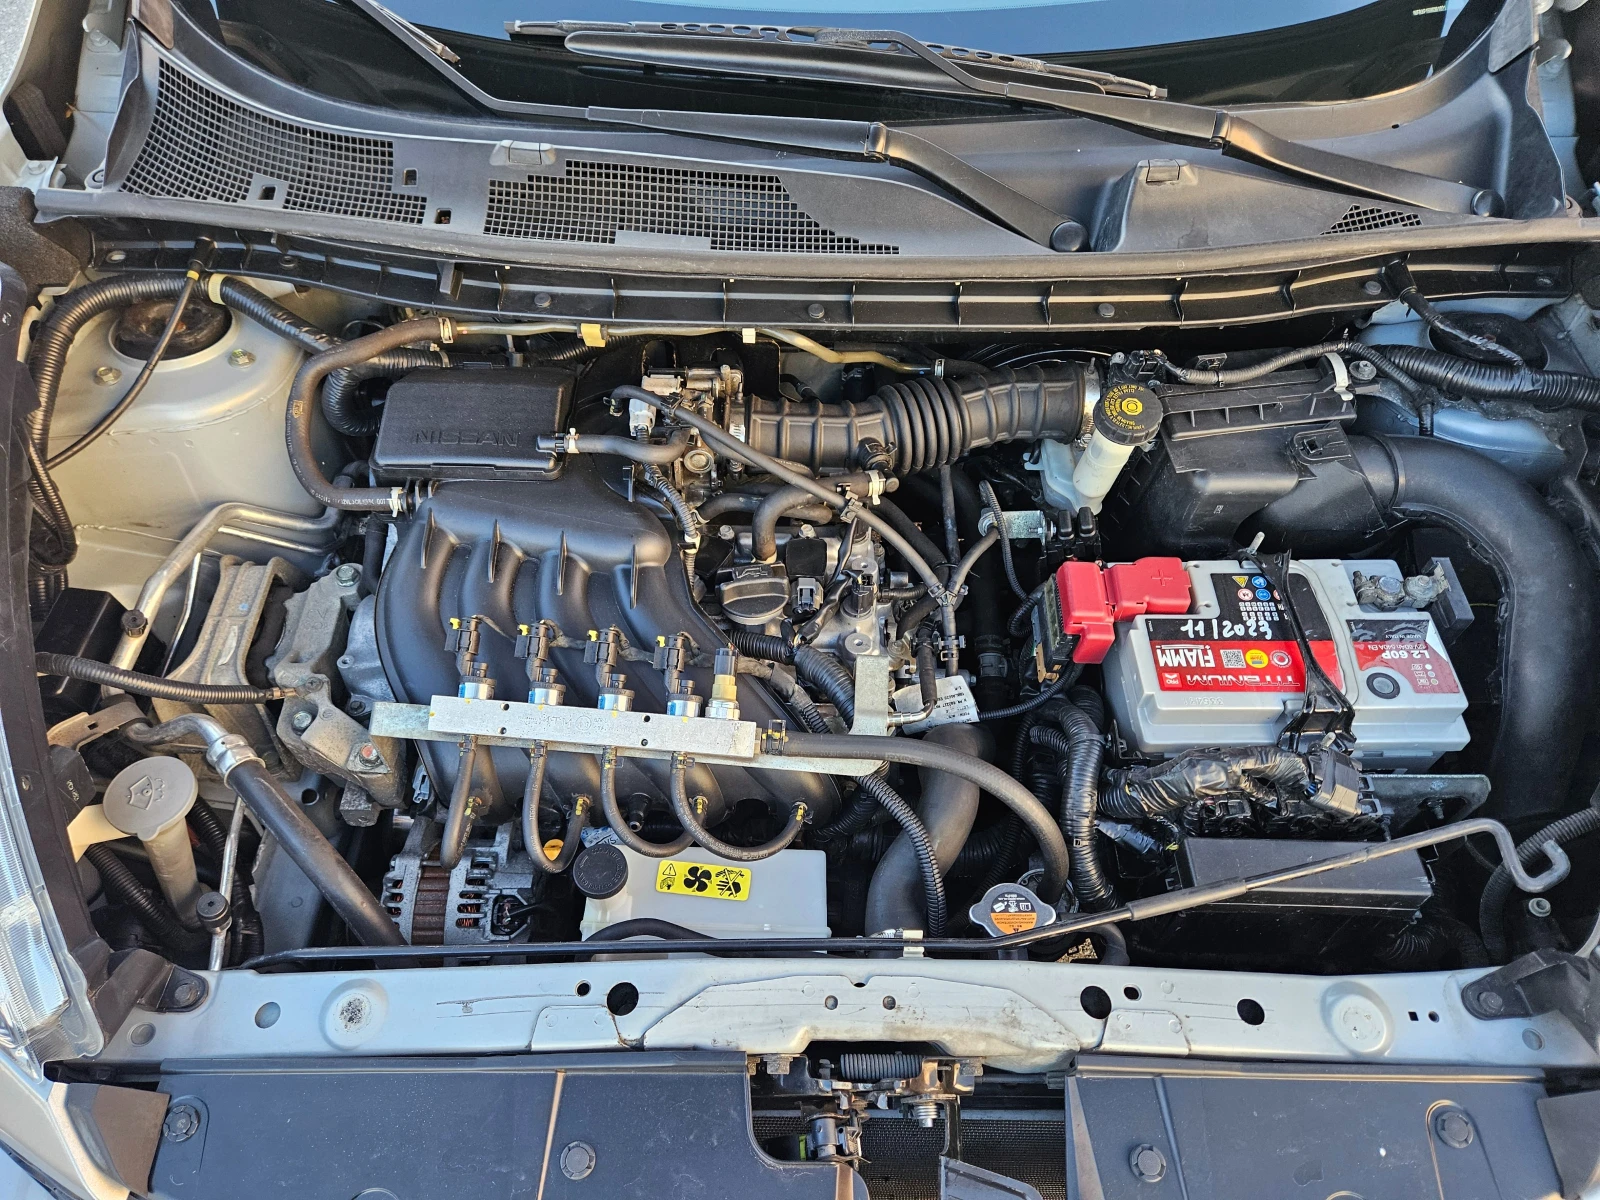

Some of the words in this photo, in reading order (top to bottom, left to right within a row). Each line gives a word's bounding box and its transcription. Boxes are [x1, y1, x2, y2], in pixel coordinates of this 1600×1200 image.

[410, 429, 519, 447] NISSAN
[1156, 647, 1216, 668] FIAMM
[1381, 649, 1409, 659] 60P
[1410, 650, 1430, 659] L2
[1185, 674, 1300, 687] TITANIUM
